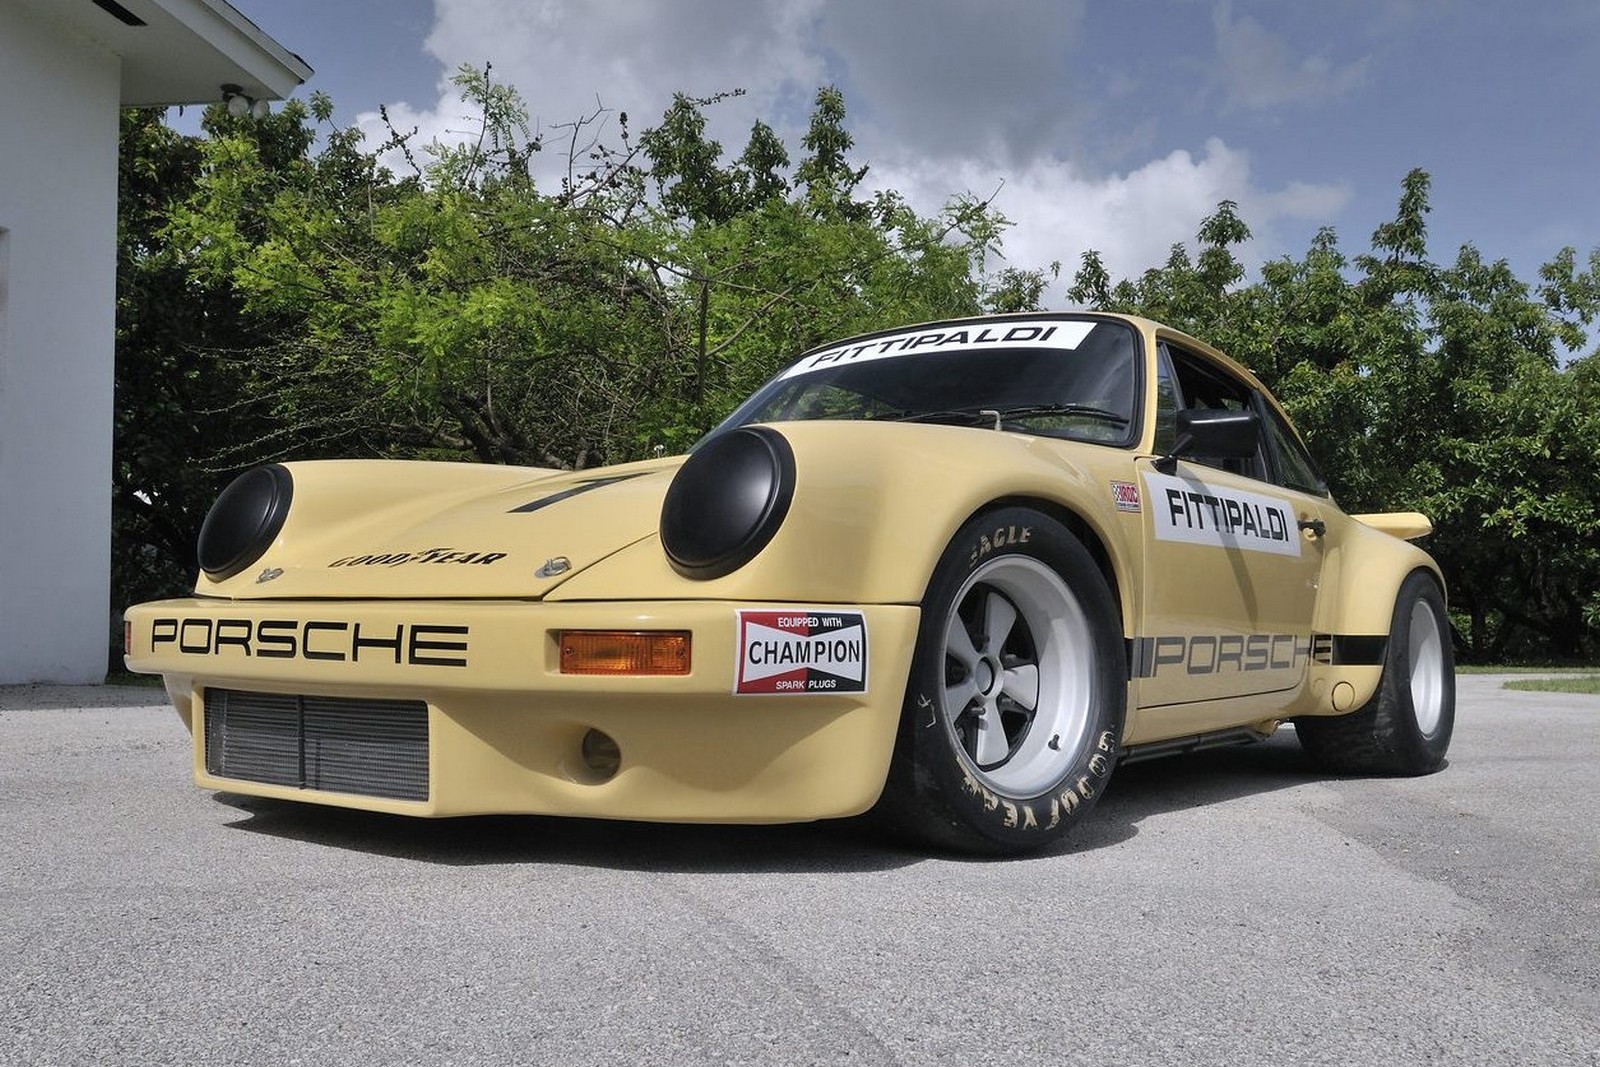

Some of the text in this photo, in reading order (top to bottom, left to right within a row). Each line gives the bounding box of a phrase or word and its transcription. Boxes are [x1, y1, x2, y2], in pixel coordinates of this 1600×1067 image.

[809, 327, 1058, 368] FITTIPALDI
[1165, 488, 1289, 542] FITTIPALDI
[969, 525, 1032, 568] EAGLE
[152, 618, 469, 667] PORSCHE
[777, 617, 843, 628] EQUIPPED WITH
[749, 640, 860, 665] CHAMPION
[1152, 633, 1332, 677] PORSCHE
[776, 679, 837, 689] SPARK PLUGS
